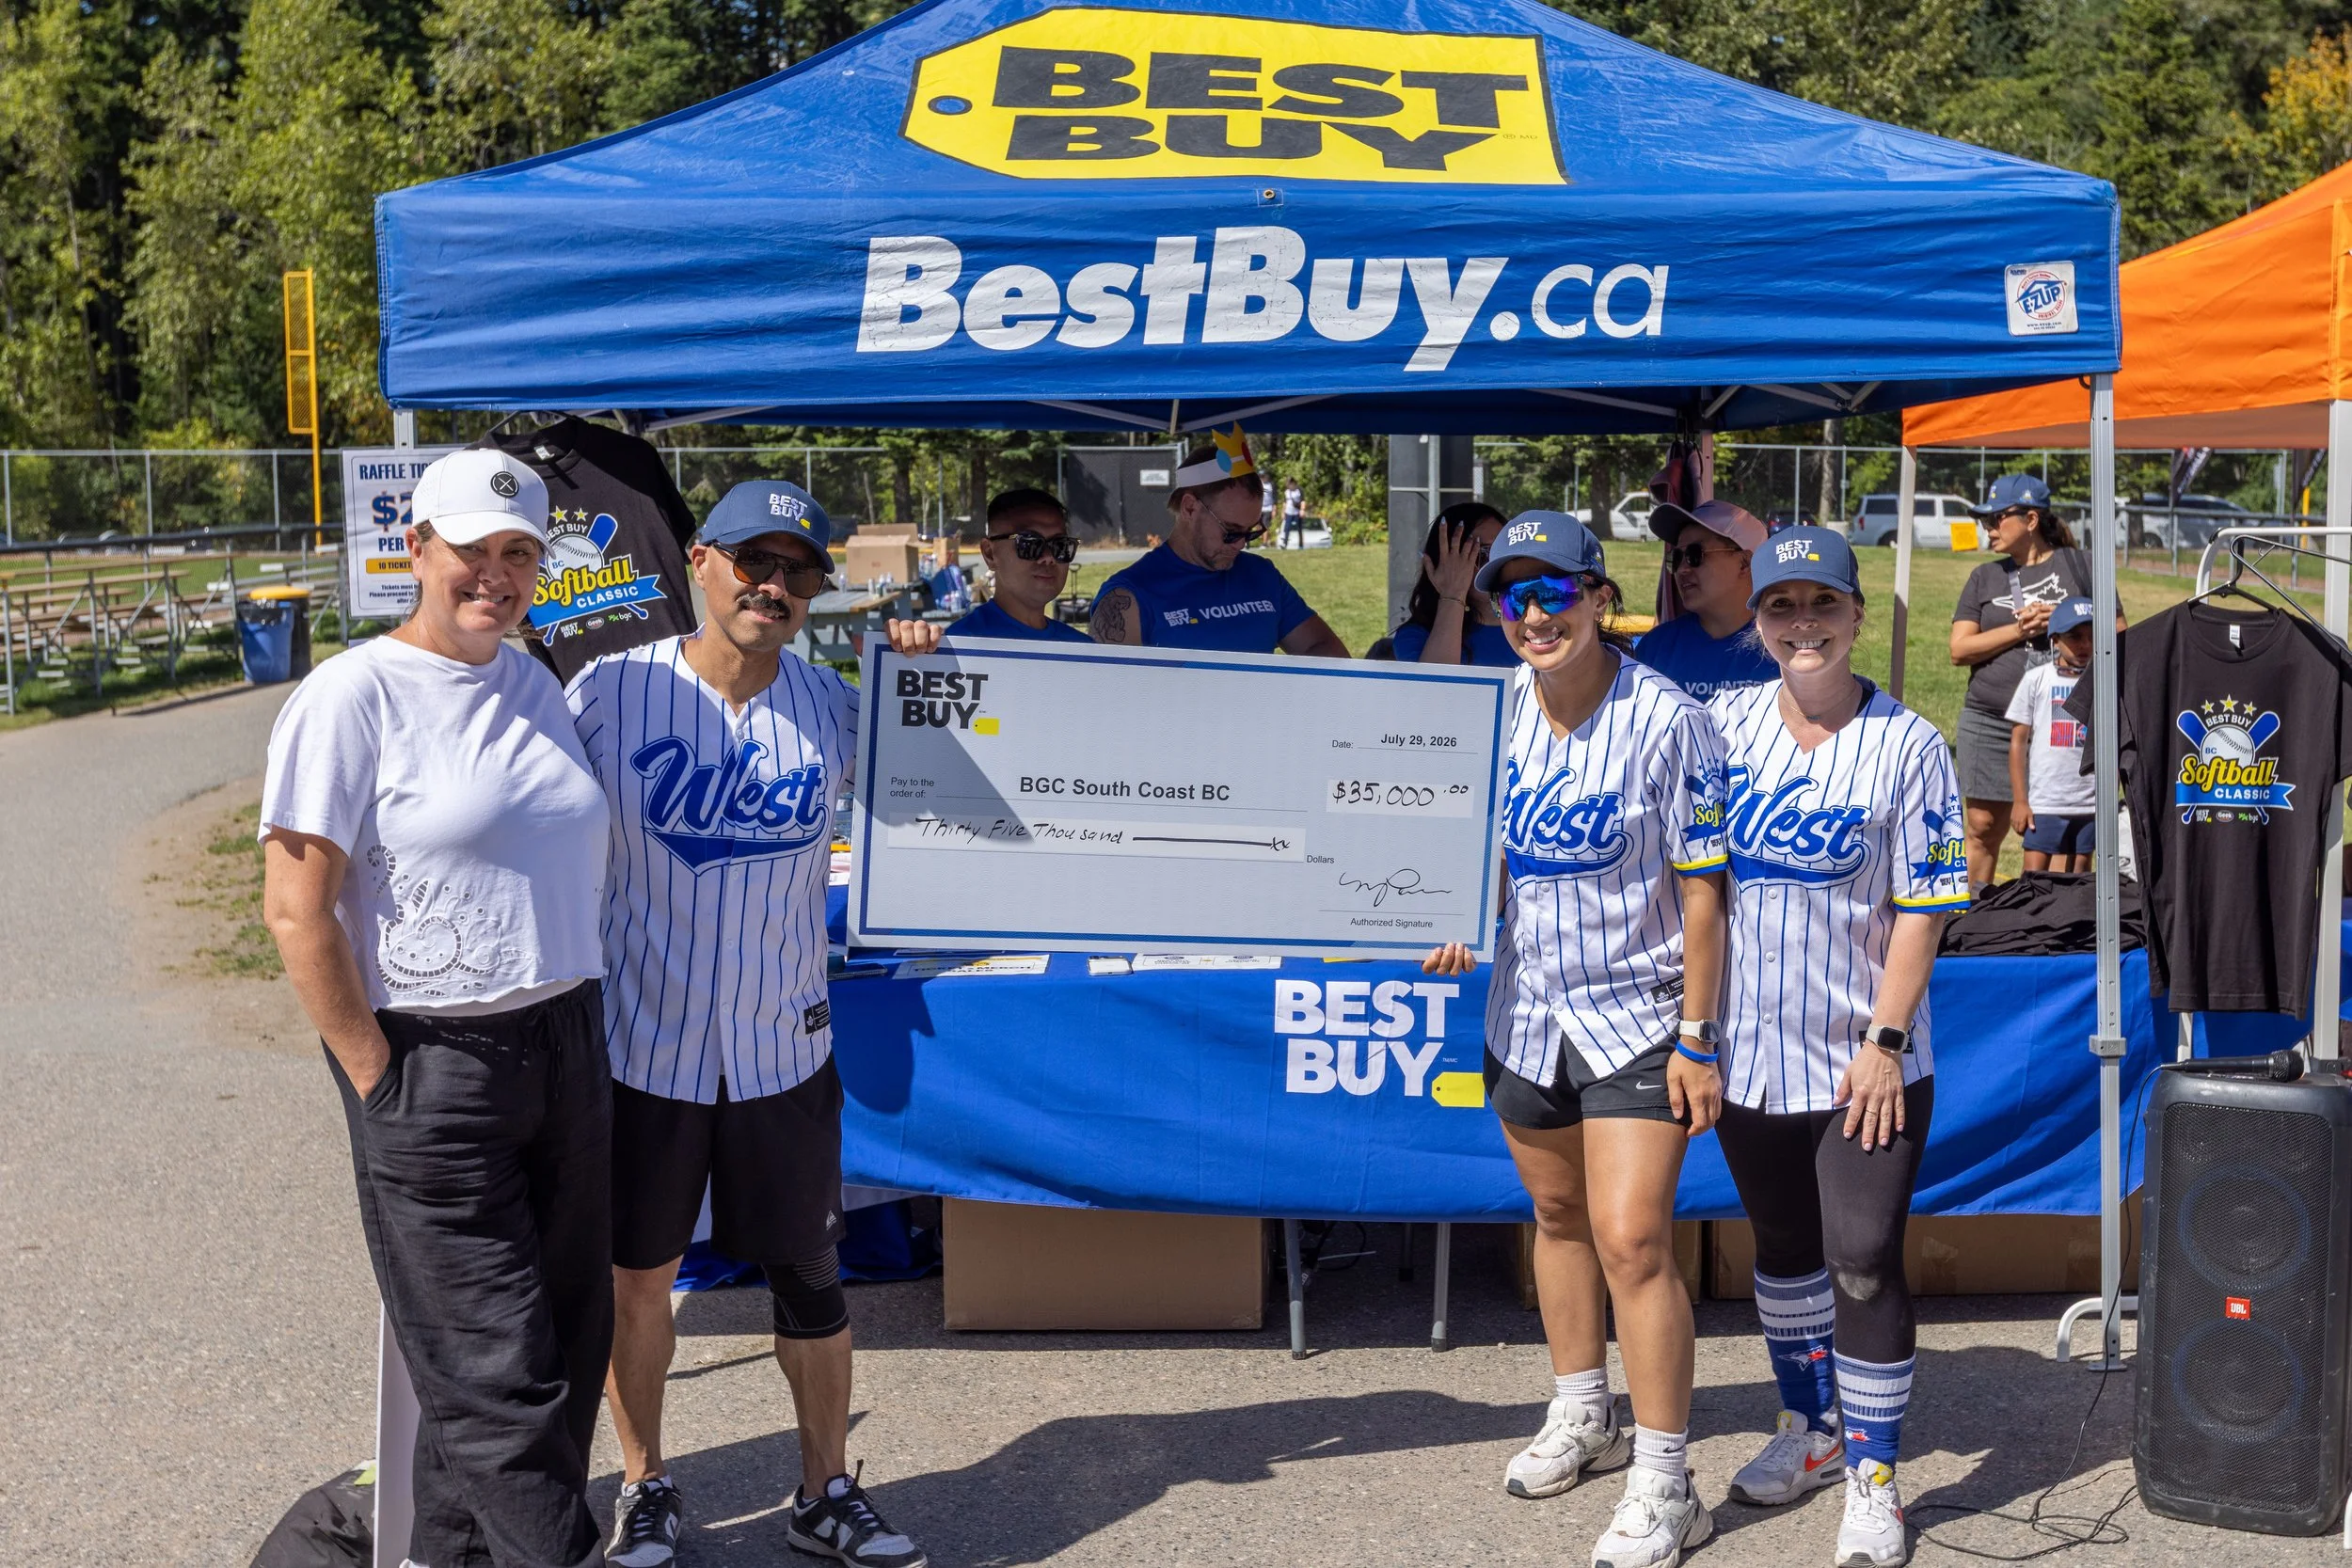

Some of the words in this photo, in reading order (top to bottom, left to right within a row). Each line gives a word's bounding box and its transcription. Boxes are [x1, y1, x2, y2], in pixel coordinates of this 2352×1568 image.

[992, 45, 1529, 129] BEST
[1006, 114, 1502, 171] BUY
[856, 225, 1671, 372] BestBuy.ca
[359, 463, 406, 480] RAFFLE
[769, 493, 808, 514] BEST
[771, 504, 804, 522] BUY
[566, 523, 588, 533] BUY
[1508, 522, 1541, 538] BEST
[378, 537, 405, 552] PER
[1509, 531, 1537, 546] BUY
[1776, 539, 1813, 555] BEST
[1778, 548, 1810, 563] BUY
[388, 560, 413, 569] TICKET
[551, 560, 564, 569] BC
[532, 558, 636, 607] Softball
[576, 586, 639, 609] CLASSIC
[618, 612, 632, 621] bgc
[1164, 609, 1189, 620] BEST
[1168, 616, 1190, 626] BUY
[897, 669, 989, 702] BEST
[901, 699, 980, 730] BUY
[2205, 714, 2230, 727] BEST
[2231, 715, 2252, 727] BUY
[1332, 739, 1354, 749] Date:
[1381, 734, 1406, 747] July
[1409, 735, 1426, 747] 29,
[1430, 736, 1457, 747] 2026
[2182, 755, 2275, 792] Softball
[630, 736, 828, 836] West
[891, 777, 908, 787] Pay
[910, 778, 919, 786] to
[921, 778, 935, 787] the
[1020, 776, 1065, 794] BGC
[1072, 778, 1131, 797] South
[1137, 781, 1196, 800] Coast
[1201, 784, 1231, 800] BC
[889, 789, 914, 798] order
[914, 789, 927, 799] of:
[2214, 788, 2270, 800] CLASSIC
[914, 817, 981, 845] Thirty
[988, 819, 1027, 839] Five
[1306, 855, 1335, 863] Dollars
[1350, 918, 1393, 927] Authorized
[1395, 919, 1433, 928] Signature
[1274, 979, 1460, 1038] BEST
[1286, 1037, 1444, 1097] BUY
[2231, 1303, 2247, 1315] JBL
